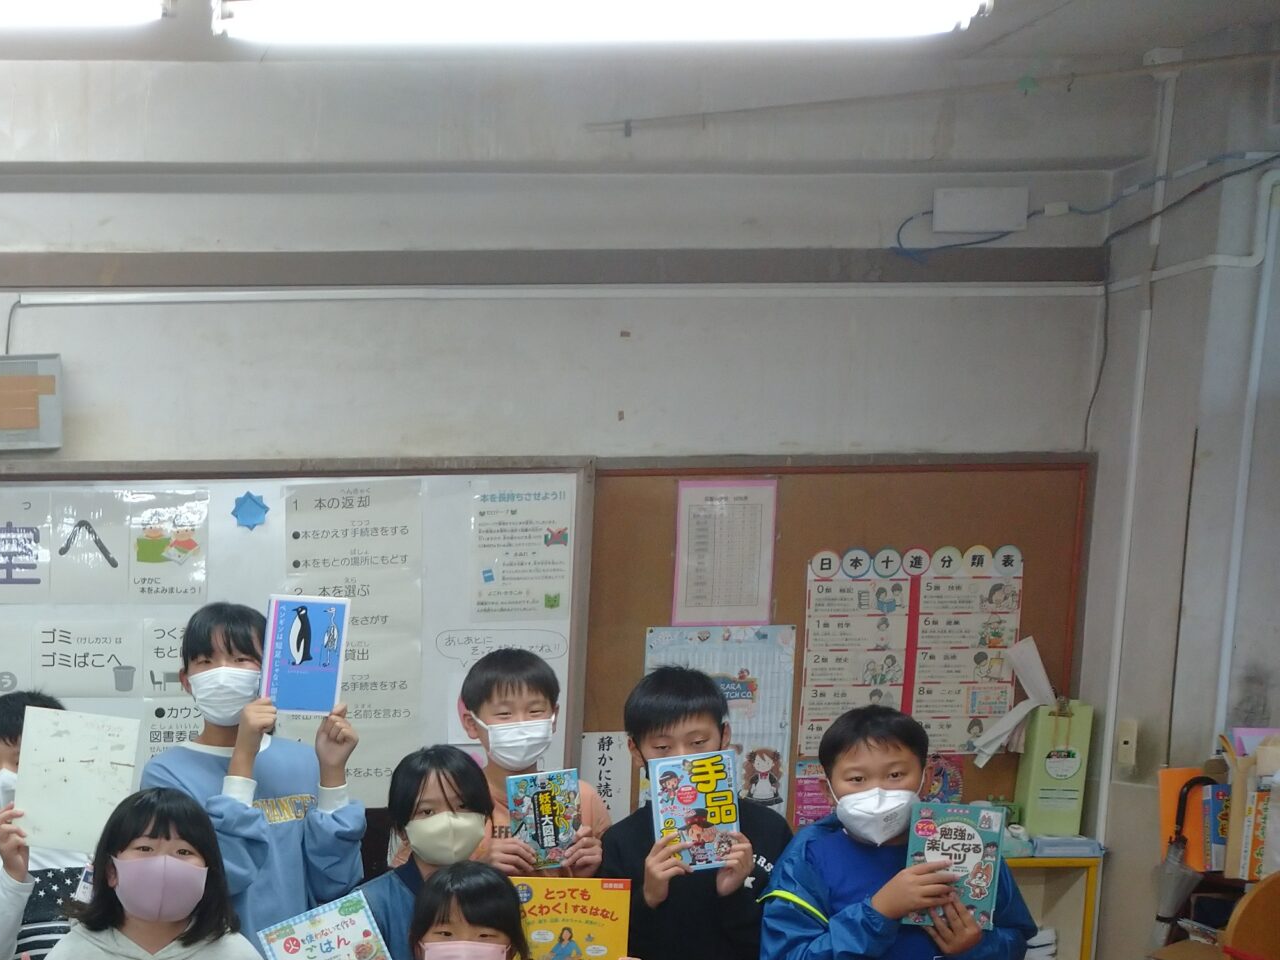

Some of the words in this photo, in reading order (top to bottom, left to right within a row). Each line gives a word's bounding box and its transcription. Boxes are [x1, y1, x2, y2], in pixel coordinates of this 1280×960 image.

[314, 496, 371, 510] 本の返却
[301, 525, 409, 540] 本をかえす手続きをする
[301, 555, 409, 569] 本をもとの場所にもどす
[820, 553, 1016, 571] 日本十進分類表
[318, 584, 371, 599] 本を選ぶ
[42, 652, 122, 668] ゴミばこへ
[154, 647, 182, 660] もと
[597, 736, 614, 810] 静かに読
[690, 754, 738, 825] 手品
[539, 793, 558, 847] 妖怪大図鑑
[939, 827, 975, 841] 勉強が
[926, 839, 982, 854] 楽しくなる
[544, 888, 591, 900] とっても
[305, 935, 351, 960] ごはん
